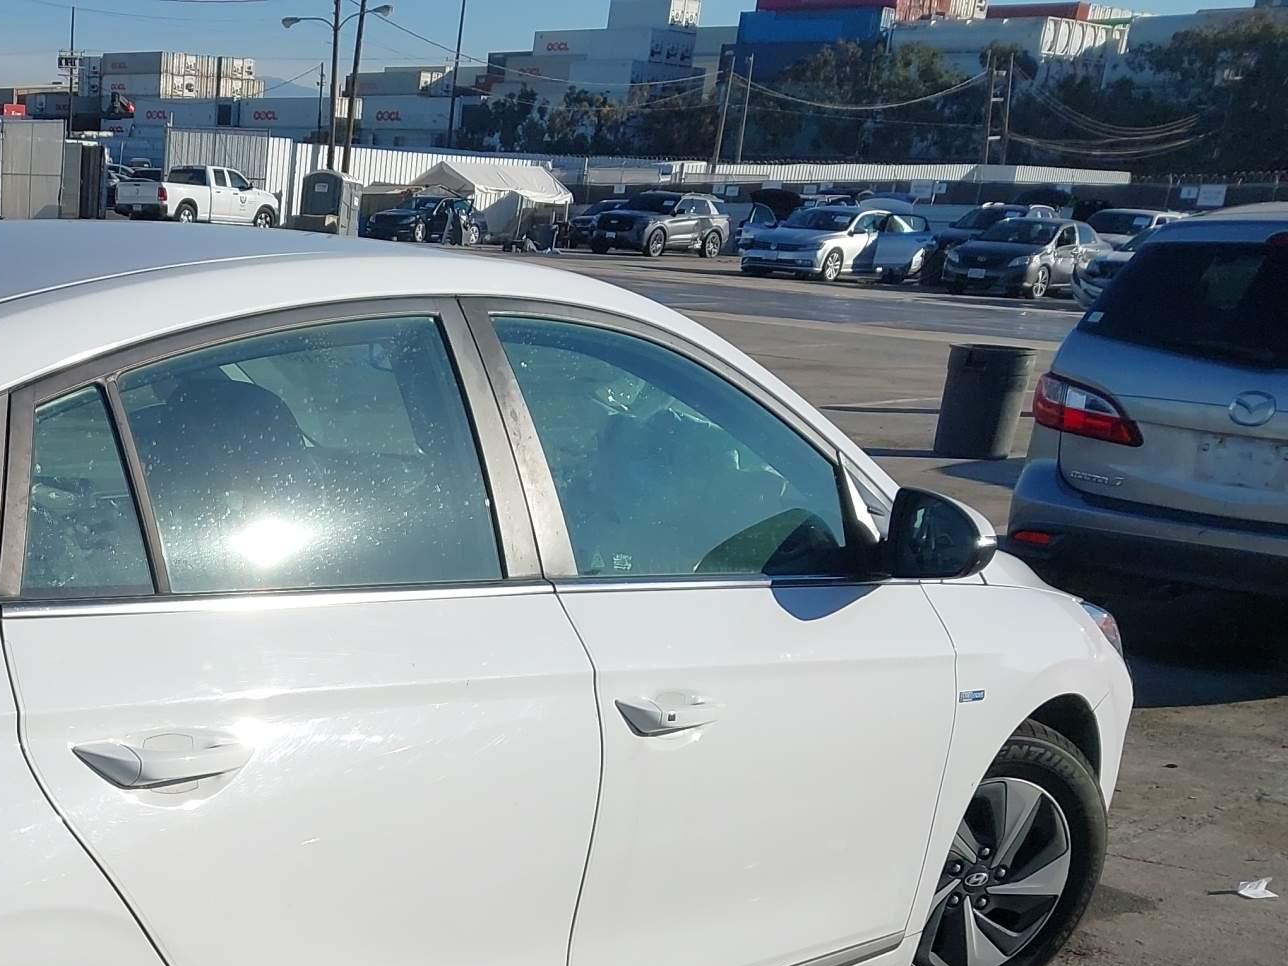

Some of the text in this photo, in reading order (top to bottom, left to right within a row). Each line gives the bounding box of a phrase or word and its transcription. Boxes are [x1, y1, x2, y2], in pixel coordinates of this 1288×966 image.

[145, 110, 168, 120] OOCL
[253, 110, 279, 121] OOCL
[375, 110, 402, 121] OOCL
